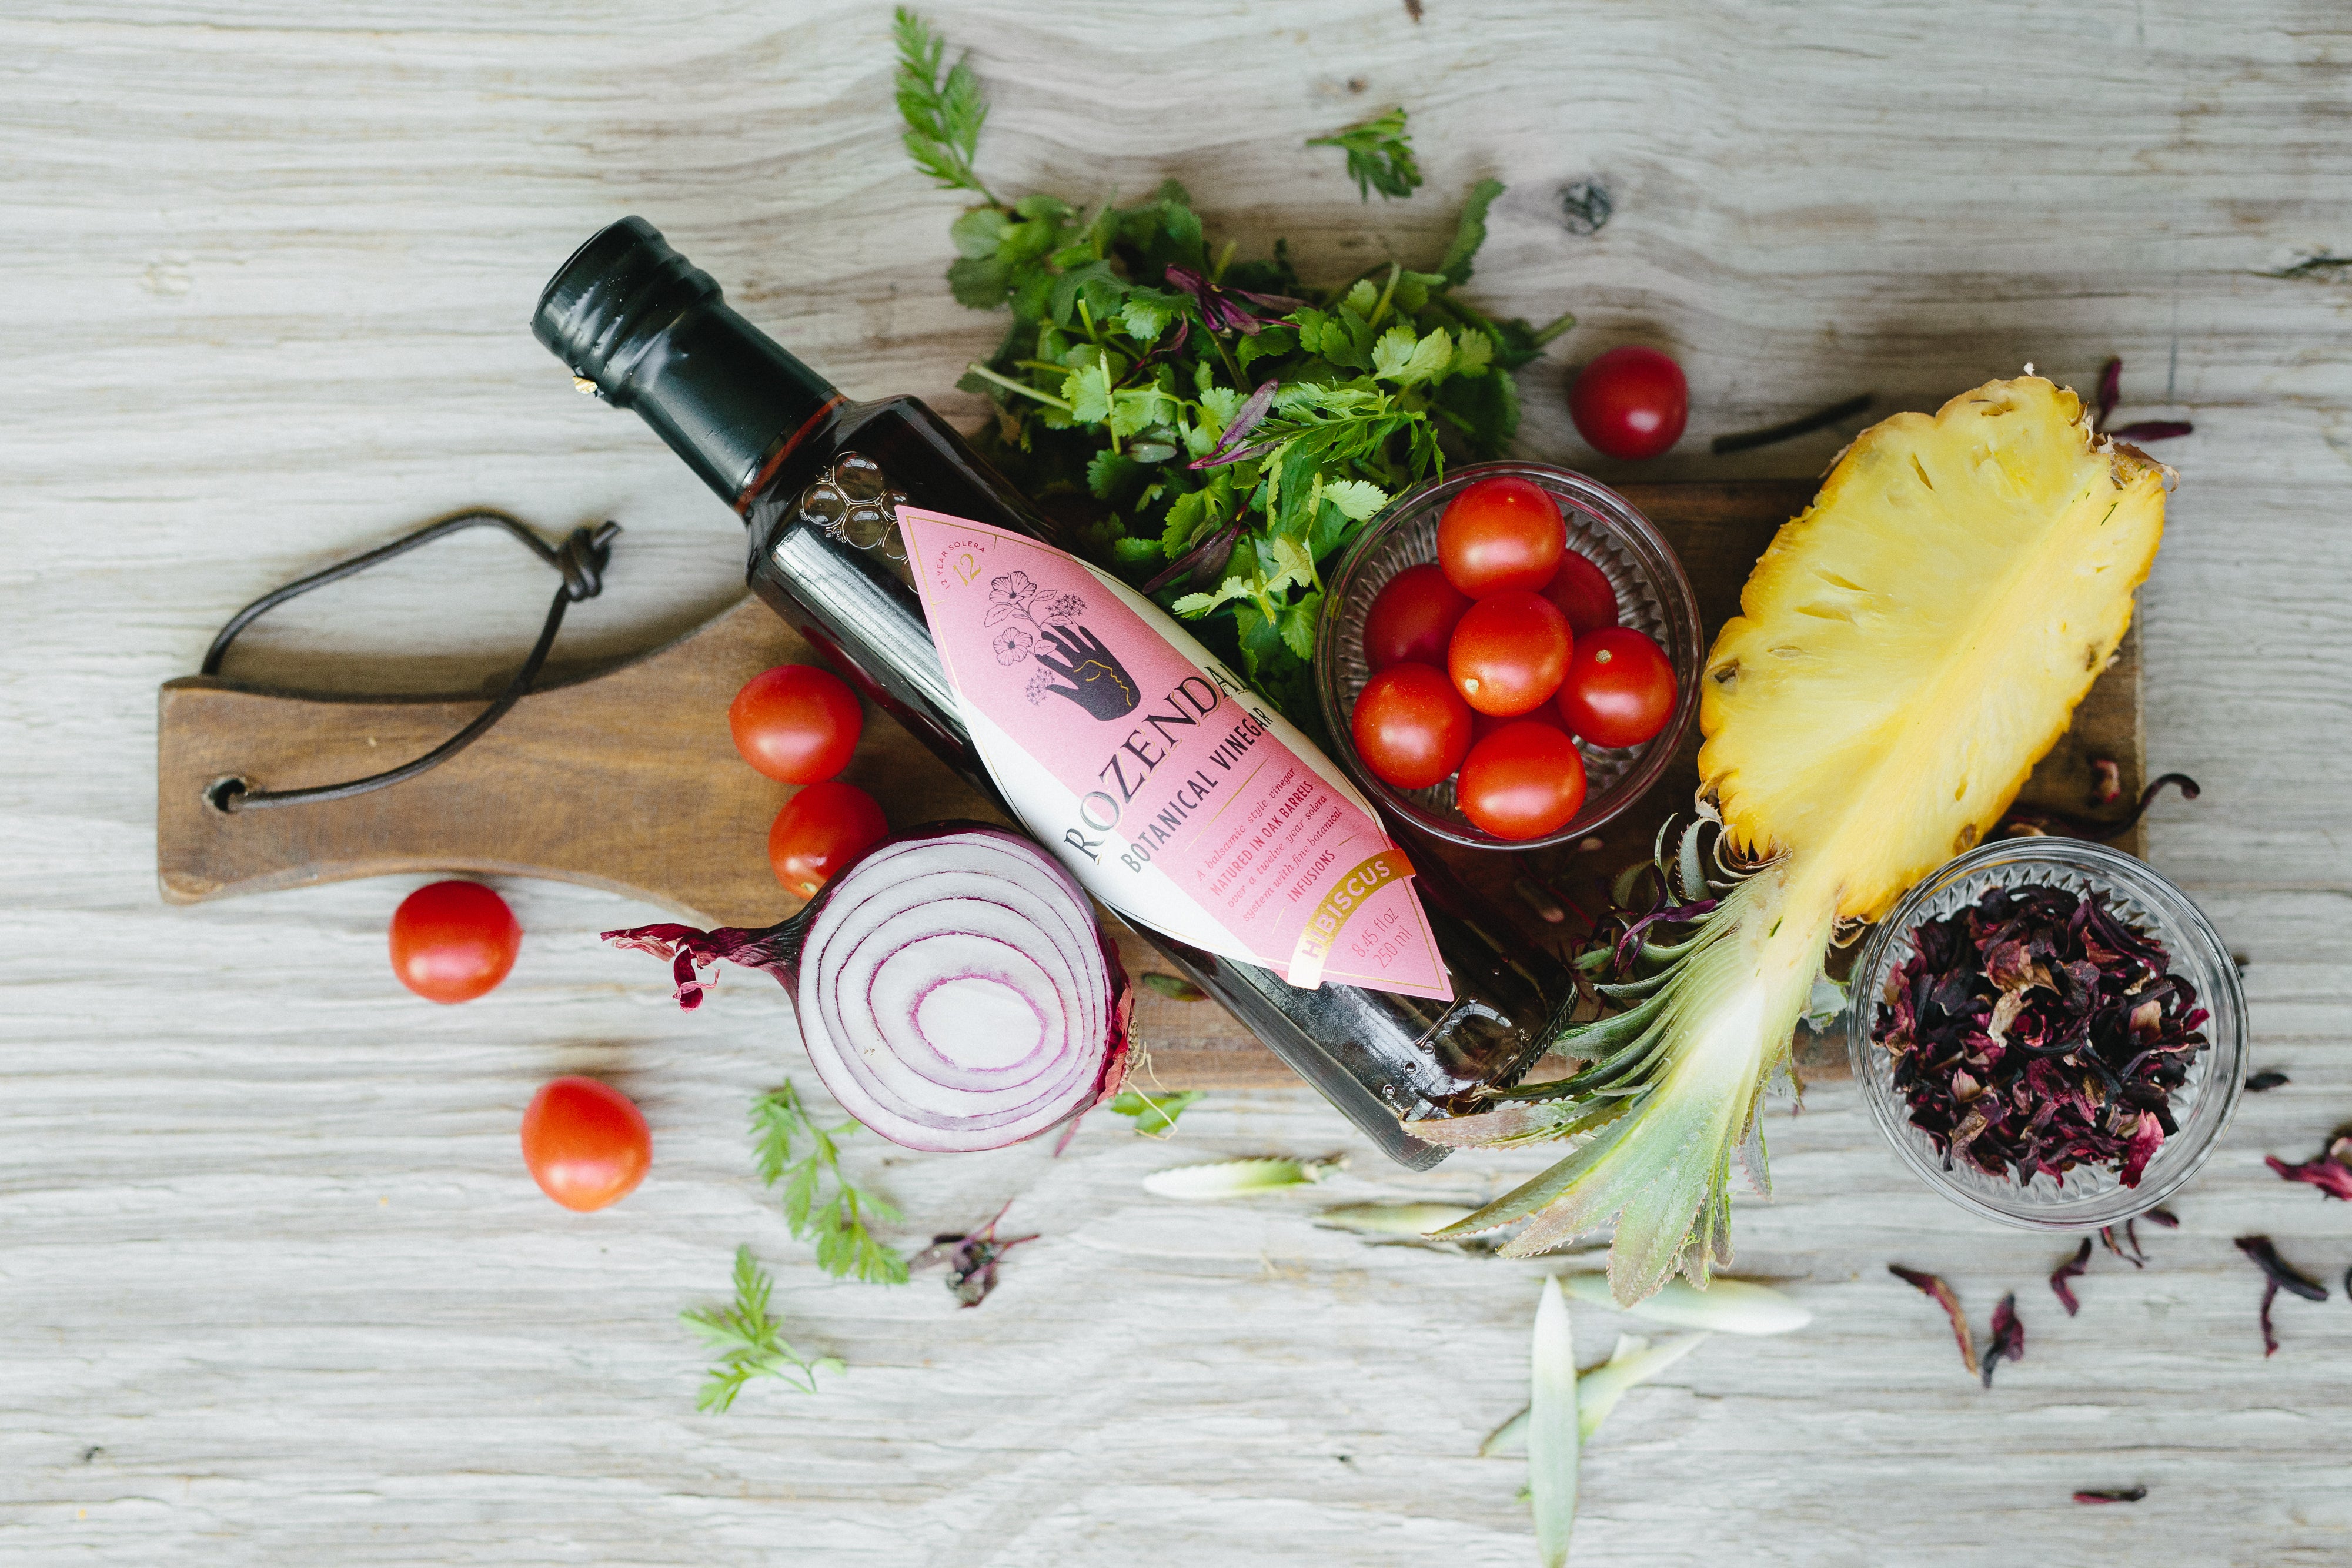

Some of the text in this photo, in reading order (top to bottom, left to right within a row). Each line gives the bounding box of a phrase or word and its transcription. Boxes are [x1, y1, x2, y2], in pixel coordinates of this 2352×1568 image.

[937, 541, 984, 590] 12 YEAR SOLERA
[953, 553, 981, 587] 12
[1120, 707, 1273, 874] BOTANICAL VINEGAR
[1197, 768, 1295, 881] A balsamic style vinegar
[1210, 780, 1314, 896] MATURED IN OAK BARRELS
[1228, 795, 1327, 908] over a twelve year solera
[1243, 806, 1342, 922] system with fine botanical
[1287, 849, 1335, 902] INFUSIONS
[1301, 860, 1391, 959] HIBISCUS
[1352, 928, 1378, 957] 8.45
[1373, 925, 1412, 968] 250 ml
